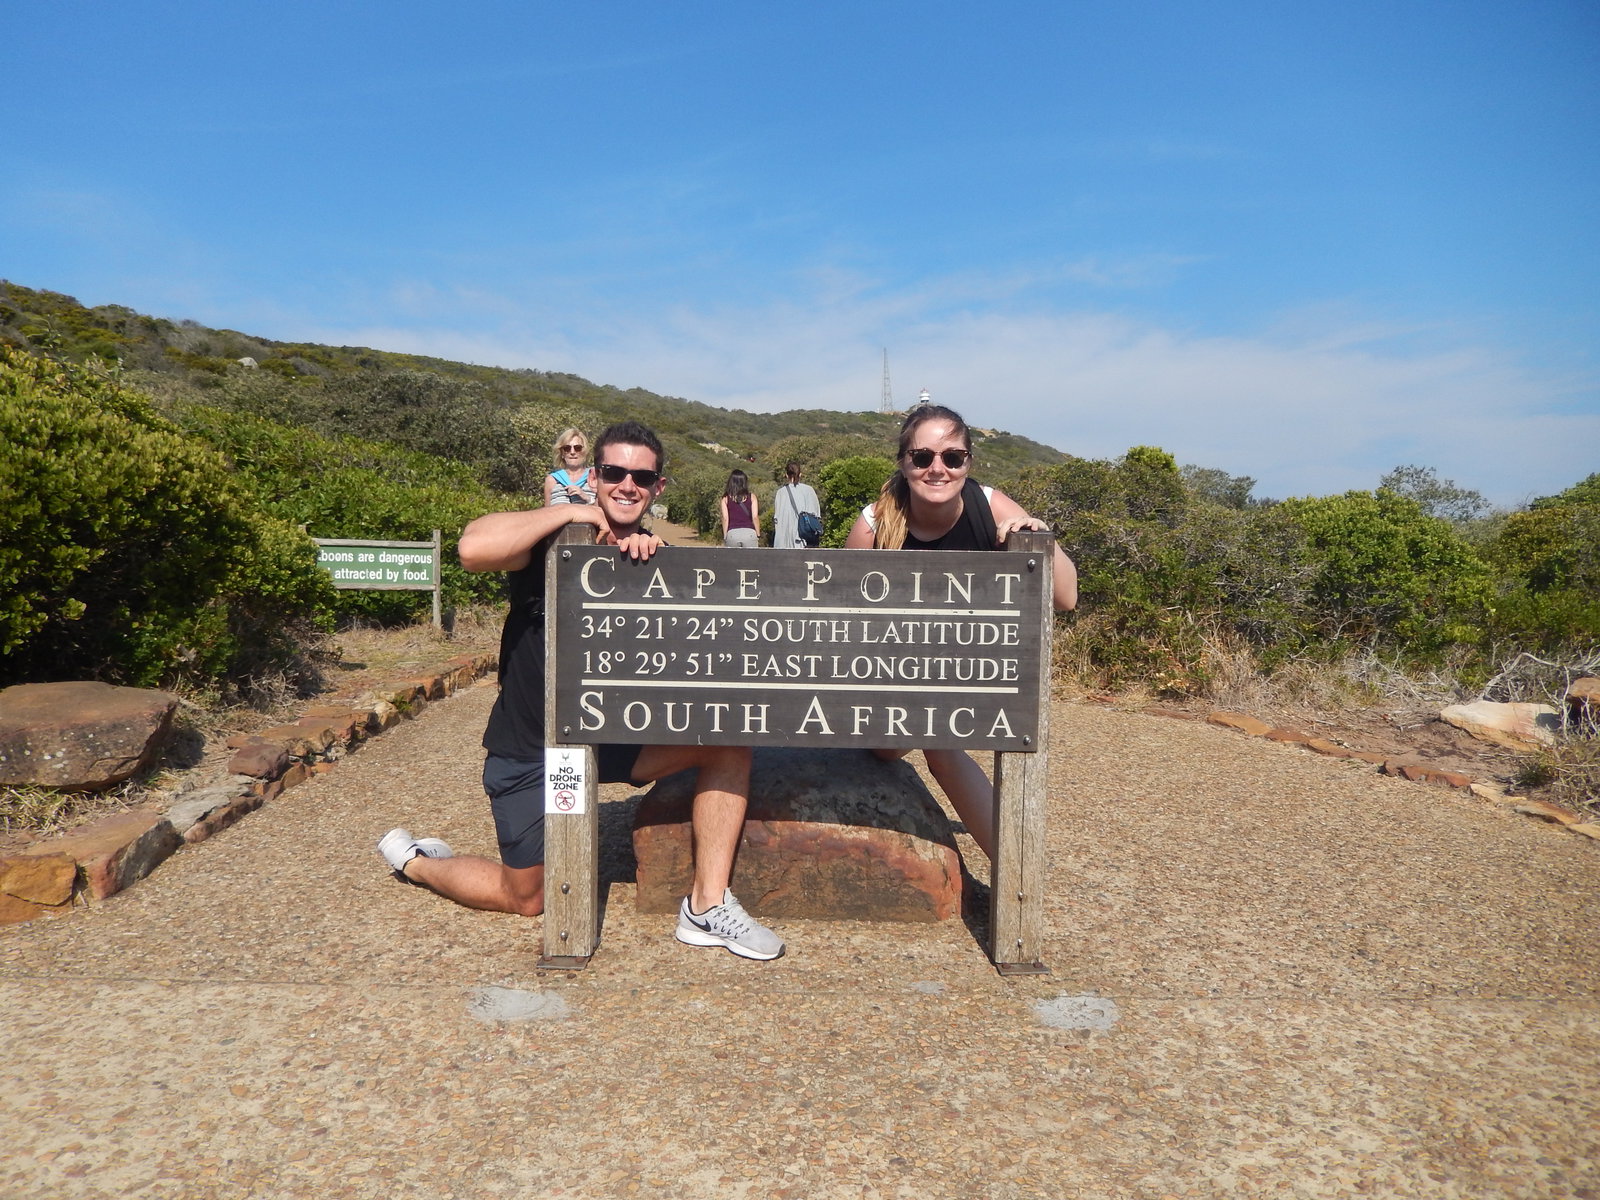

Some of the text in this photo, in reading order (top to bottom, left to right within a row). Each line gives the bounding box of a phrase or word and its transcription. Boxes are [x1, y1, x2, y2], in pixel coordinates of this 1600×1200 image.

[358, 553, 375, 562] are
[378, 551, 433, 565] dangerous
[334, 568, 383, 580] attracted
[386, 568, 399, 582] by
[403, 569, 430, 580] food.
[580, 556, 1021, 604] CAPE POINT
[581, 615, 626, 638] 34°
[743, 618, 851, 643] SOUTH
[860, 620, 1020, 646] LATITUDE
[583, 650, 626, 674] 18°
[741, 654, 823, 678] EAST
[831, 655, 1019, 681] LONGITUDE
[579, 691, 1017, 738] SOUTH AFRICA
